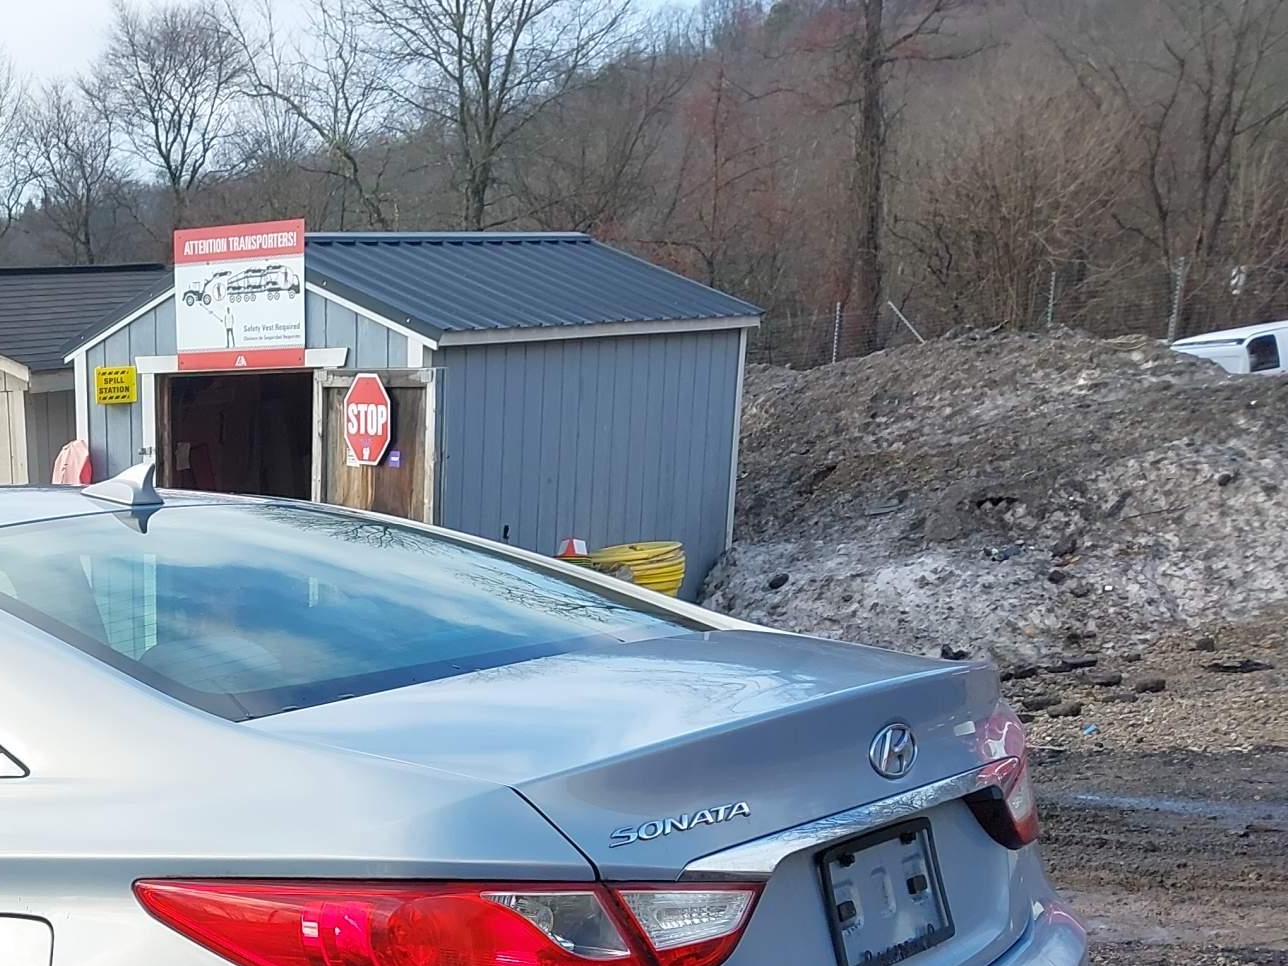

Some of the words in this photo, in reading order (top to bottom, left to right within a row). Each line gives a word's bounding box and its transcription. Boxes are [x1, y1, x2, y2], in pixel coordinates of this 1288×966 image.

[184, 238, 227, 255] ATTENTION
[228, 231, 297, 252] TRANSPORTERS!
[98, 385, 130, 395] STATION
[103, 376, 125, 385] SPILL
[347, 403, 387, 436] STOP
[609, 800, 751, 848] SONATA
